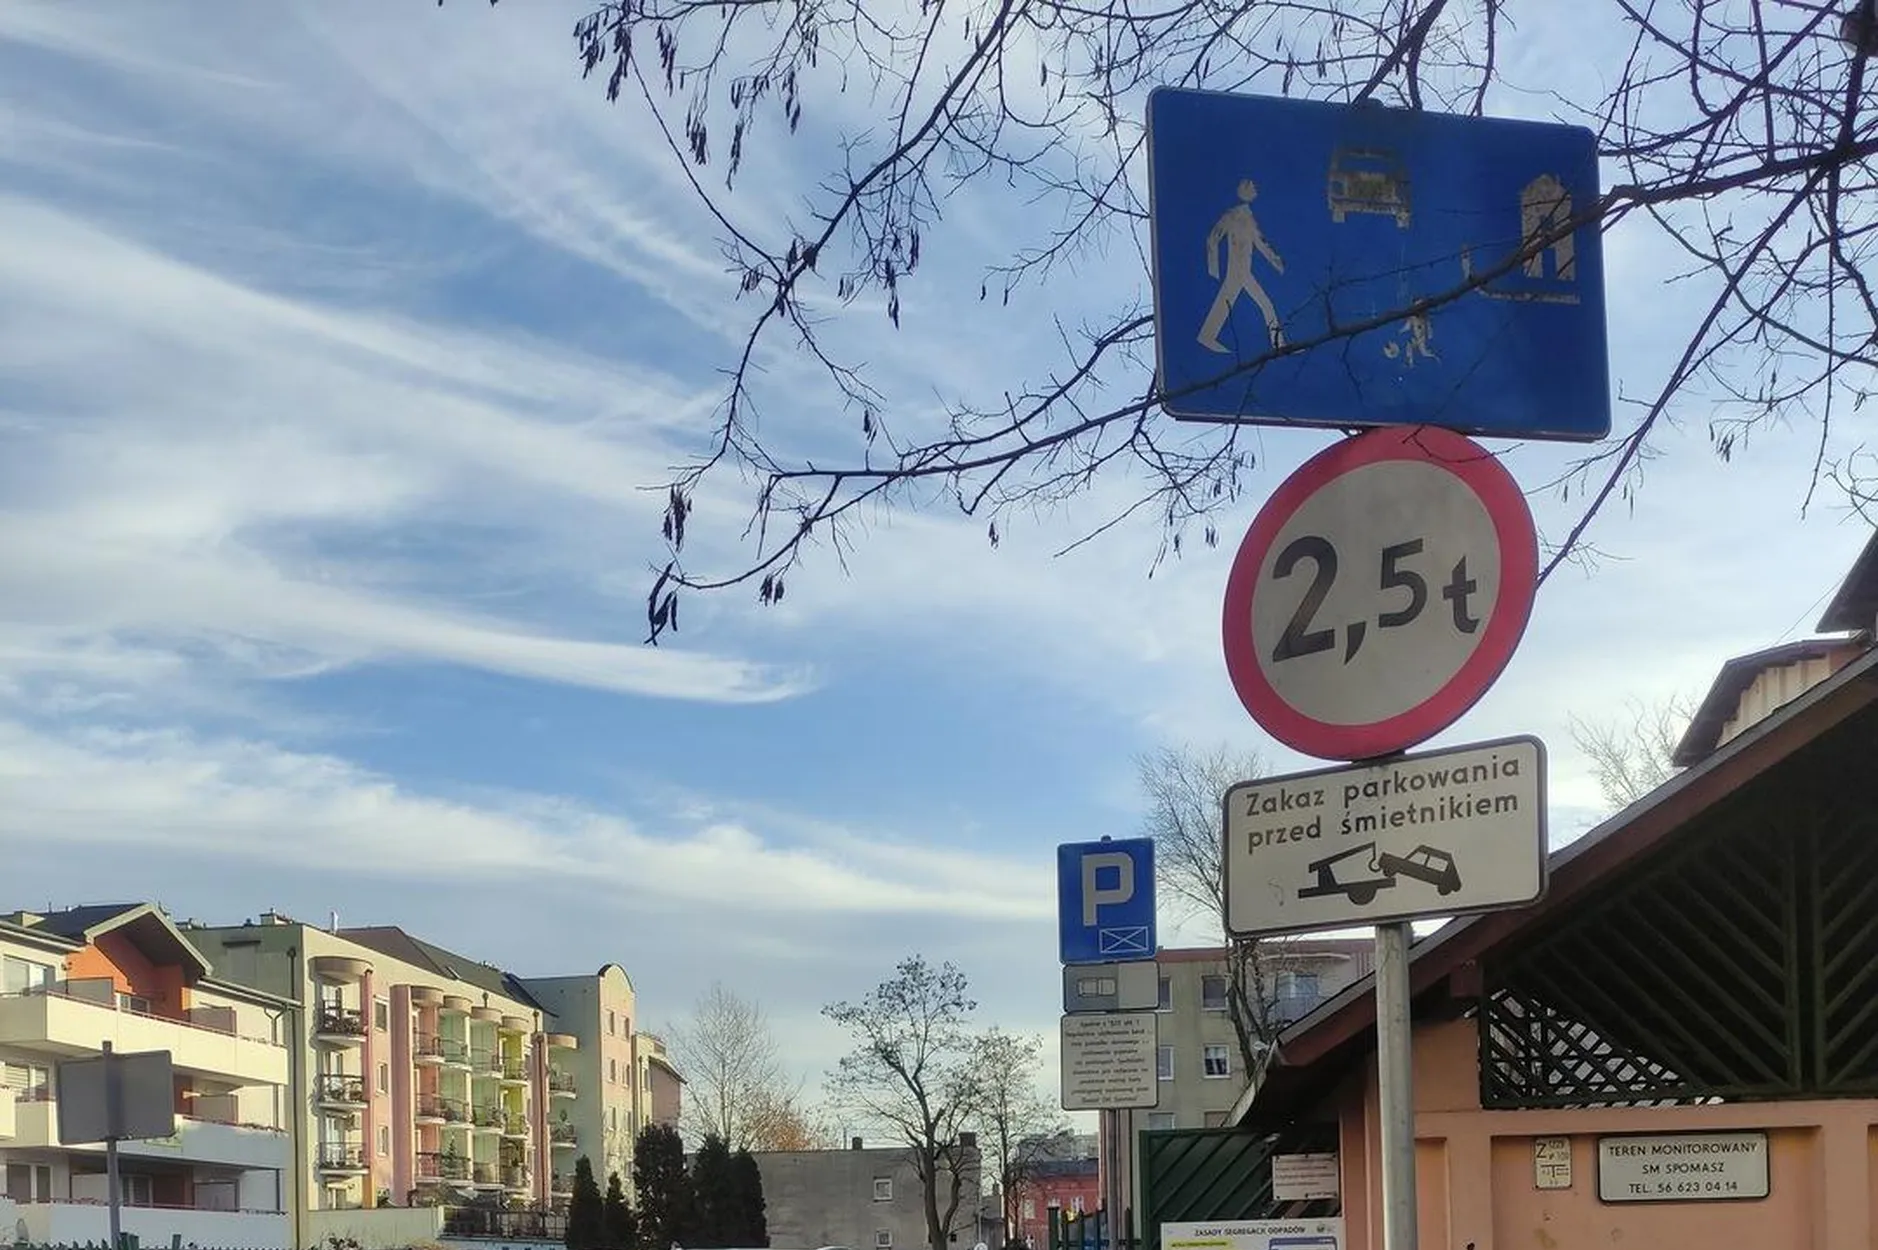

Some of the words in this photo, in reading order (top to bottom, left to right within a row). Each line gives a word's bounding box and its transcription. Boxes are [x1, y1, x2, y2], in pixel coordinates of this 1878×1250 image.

[1246, 786, 1325, 817] Zakaz
[1344, 754, 1520, 808] parkowania
[1248, 815, 1322, 855] przed
[1341, 791, 1519, 836] śmietnikiem
[1081, 851, 1135, 927] P
[1609, 1145, 1646, 1156] TEREN
[1652, 1142, 1758, 1155] MONITOROWANY
[1642, 1164, 1660, 1174] SM
[1665, 1162, 1725, 1174] SPOMASZ
[1629, 1183, 1651, 1194] TEL.
[1657, 1182, 1673, 1193] 56
[1677, 1182, 1700, 1193] 623
[1705, 1181, 1721, 1192] 04
[1725, 1181, 1738, 1191] 14
[1195, 1228, 1223, 1237] ZASADY
[1267, 1225, 1306, 1234] ODPADÓW
